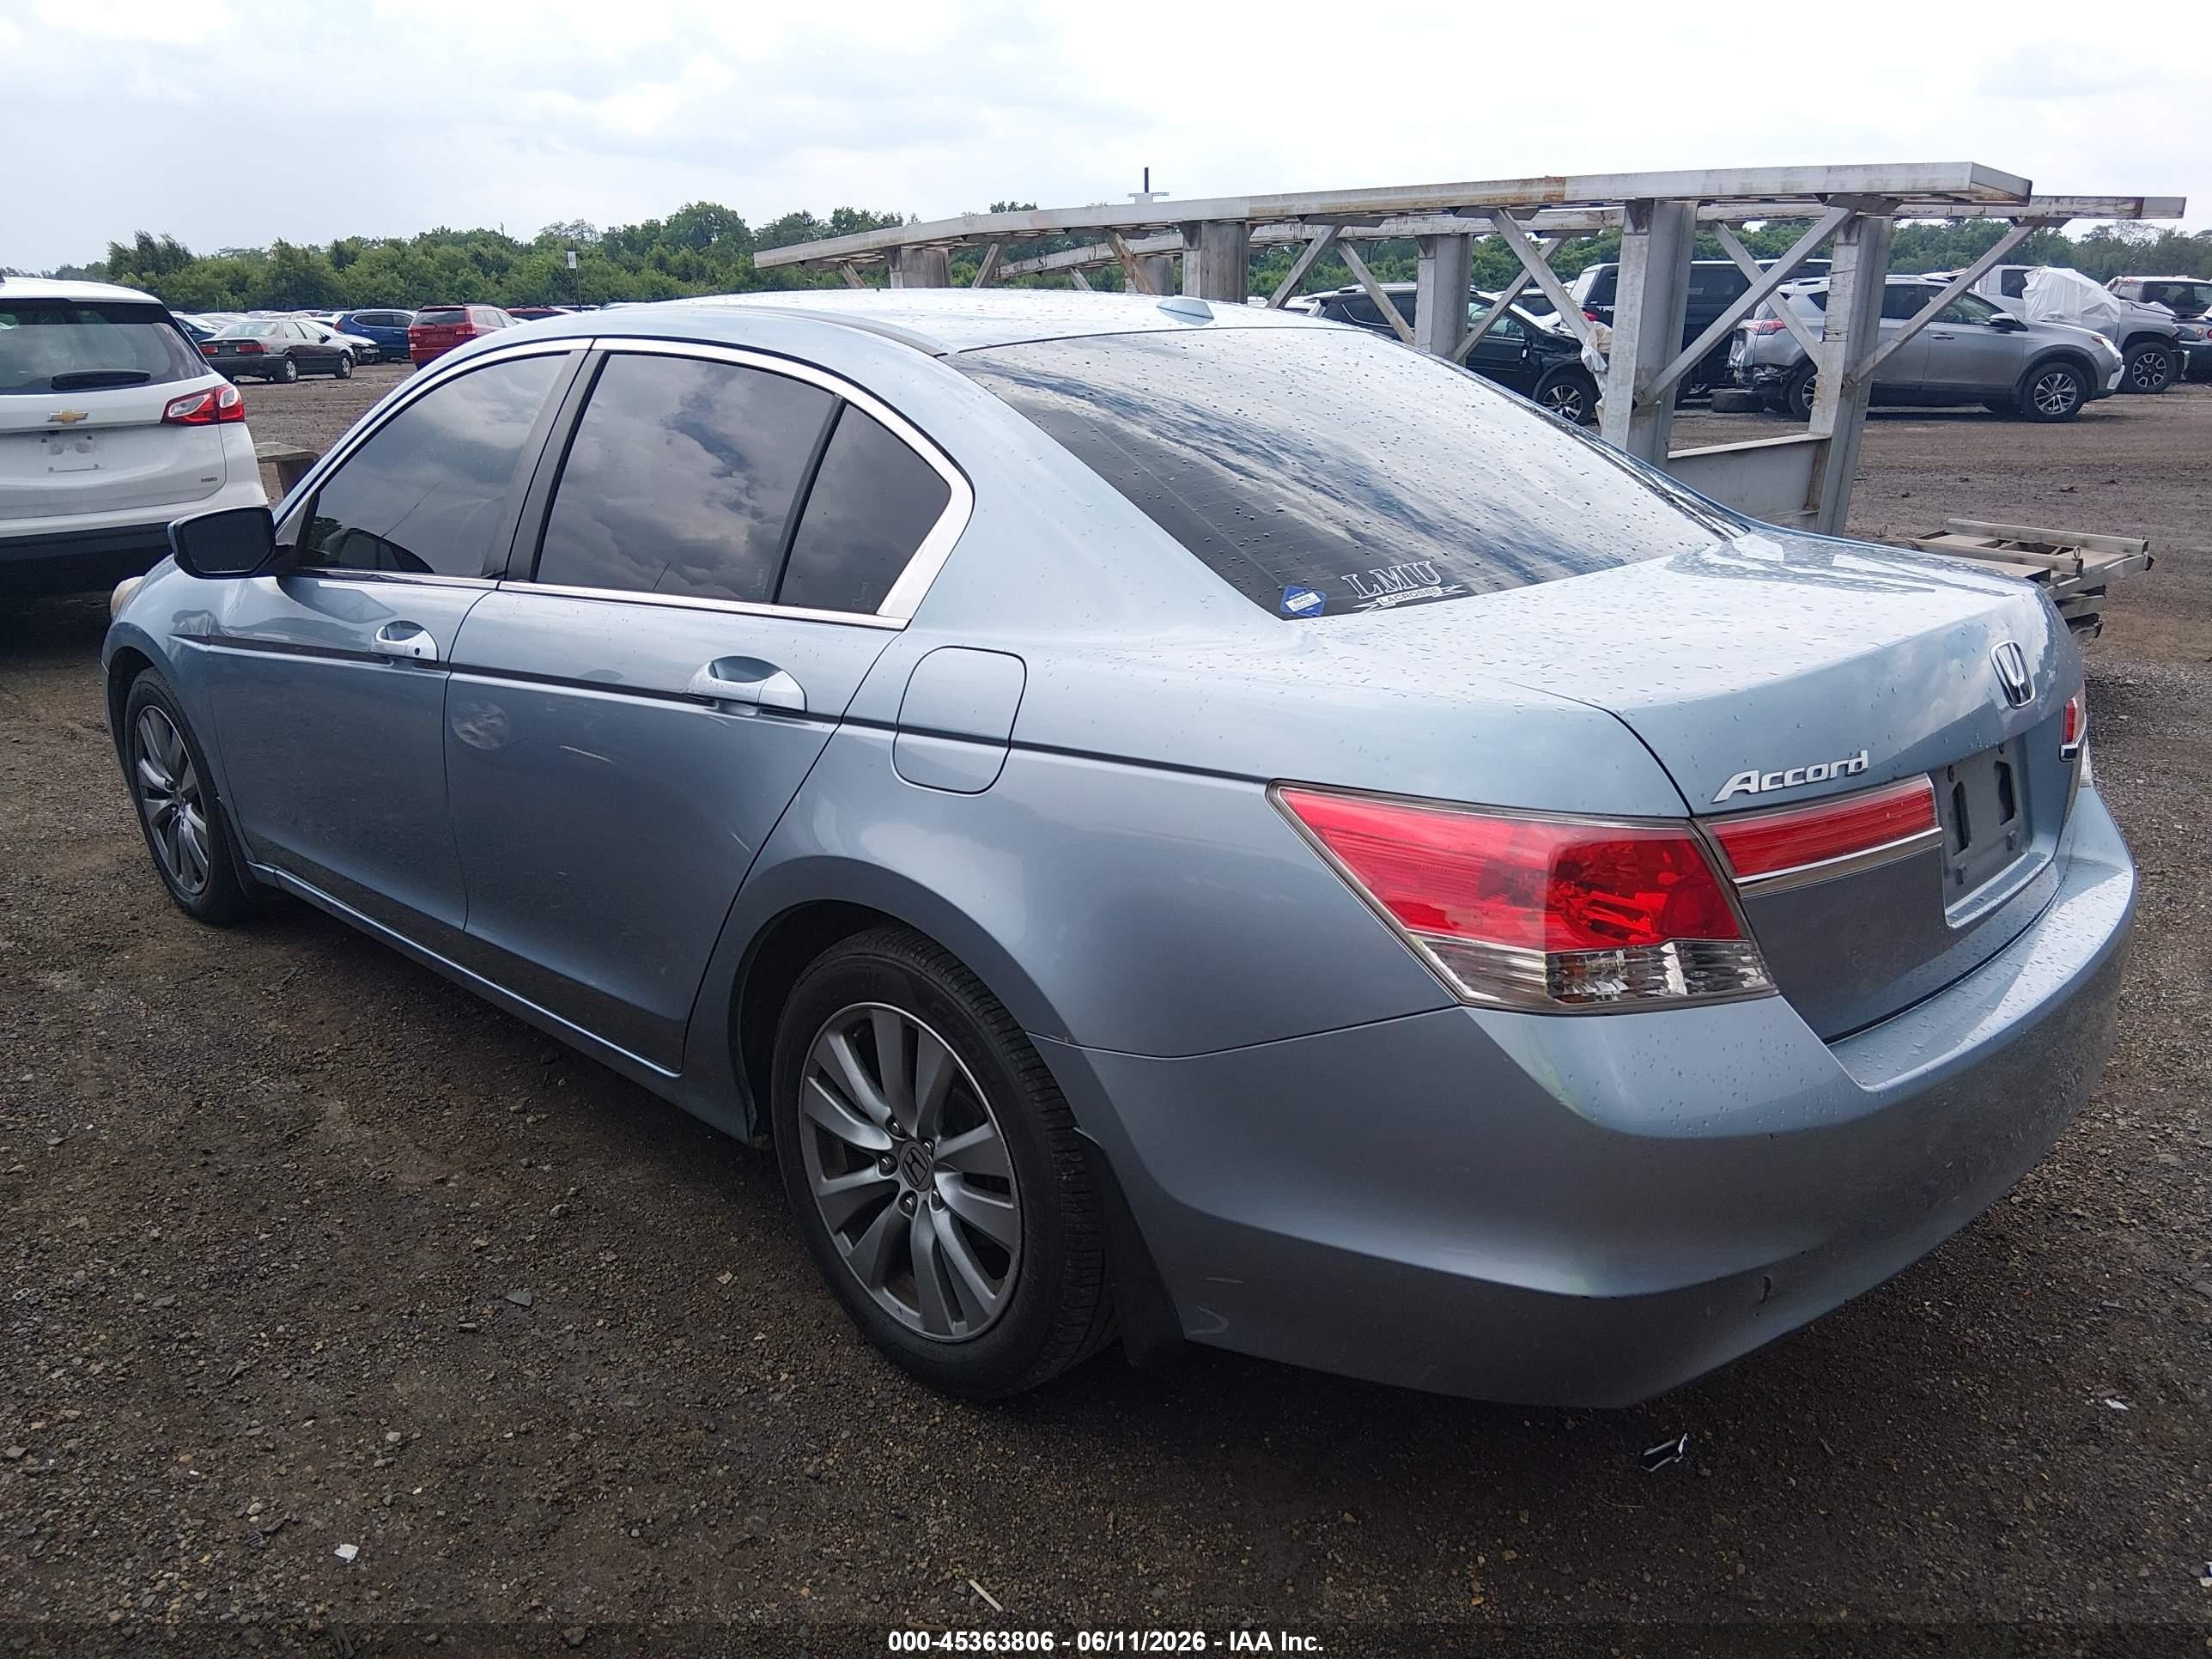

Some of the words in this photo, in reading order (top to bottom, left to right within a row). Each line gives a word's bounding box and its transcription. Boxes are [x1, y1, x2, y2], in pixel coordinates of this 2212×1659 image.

[1340, 561, 1442, 599] LMU
[1378, 587, 1440, 605] LACROSSE
[1711, 750, 1869, 804] Accord
